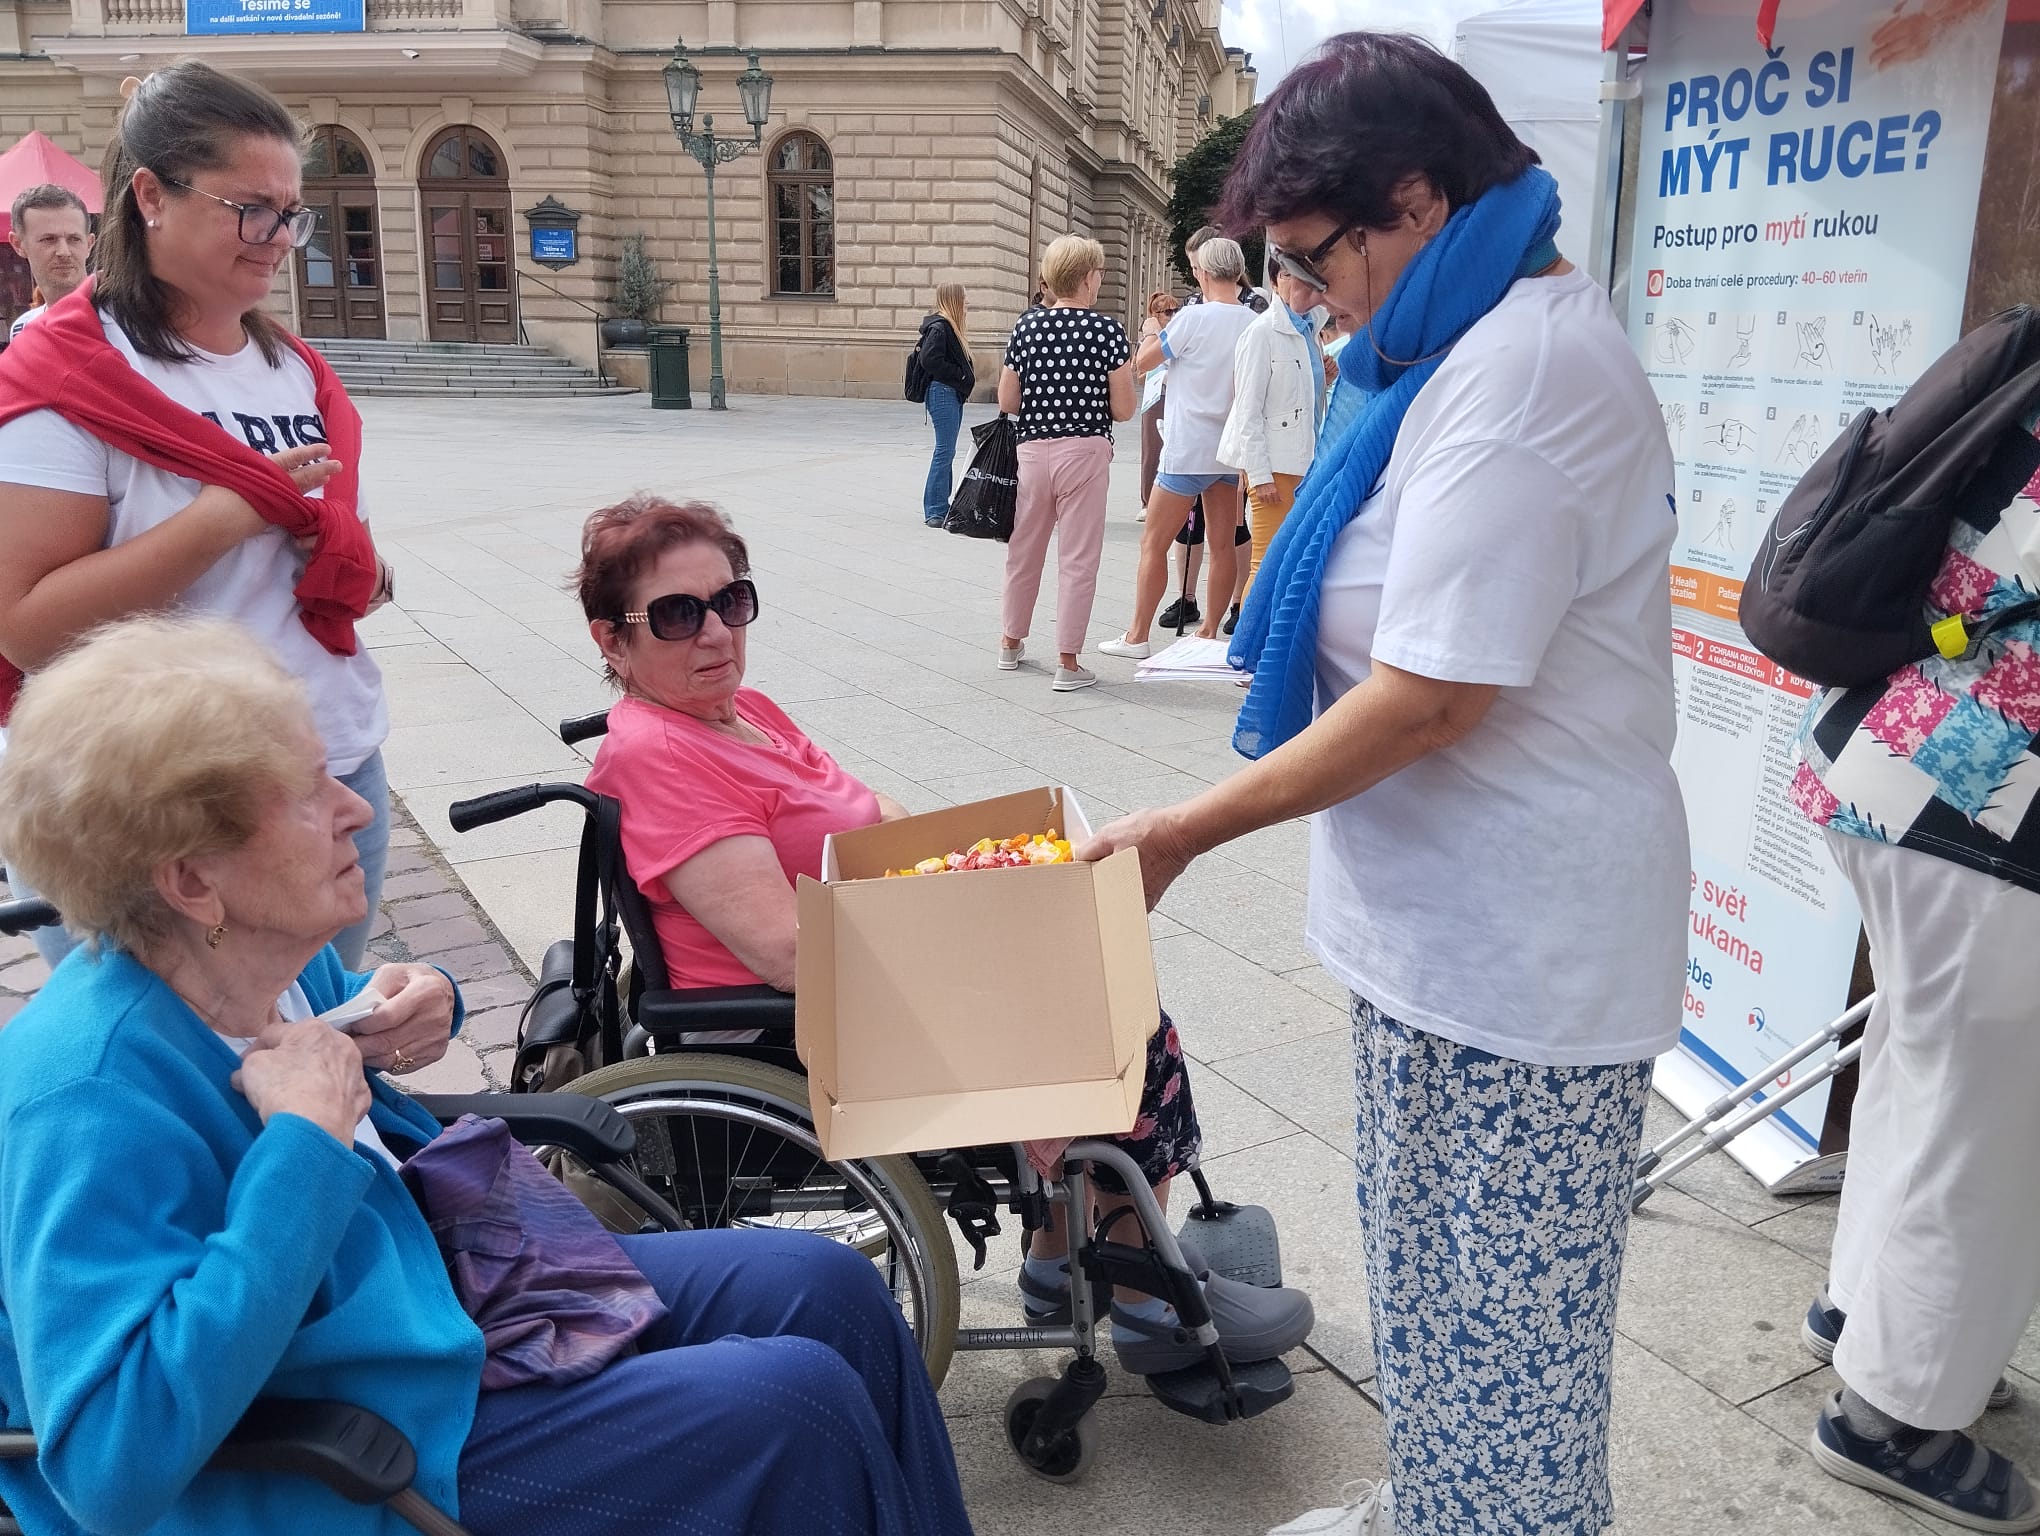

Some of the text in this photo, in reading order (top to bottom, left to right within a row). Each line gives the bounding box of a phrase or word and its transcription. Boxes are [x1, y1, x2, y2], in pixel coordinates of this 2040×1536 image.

[294, 0, 310, 10] se
[220, 14, 234, 23] další
[236, 14, 260, 22] setkání
[284, 13, 315, 21] divadelní
[1664, 46, 1855, 132] PROČ SI
[1658, 110, 1942, 198] MÝT RUCE?
[1653, 210, 1878, 250] Postup pro mytí rukou
[1666, 275, 1692, 289] Doba
[1694, 274, 1719, 289] trvání
[1720, 273, 1744, 287] celé
[1747, 272, 1799, 290] procedury:
[1838, 269, 1868, 284] vteřin
[1757, 500, 1766, 512] 10
[1676, 576, 1697, 589] Health
[1695, 641, 1704, 659] 2
[1709, 645, 1758, 666] OCHRANA OKOLÍ
[1714, 654, 1736, 669] NAŠICH
[1737, 662, 1765, 679] BLÍZKÝCH
[1775, 666, 1784, 685] 3
[1790, 676, 1805, 688] KDY
[1805, 681, 1812, 690] SI
[1703, 880, 1748, 923] svět
[1684, 986, 1704, 1018] be
[968, 1329, 1044, 1344] EUROCHAIR
